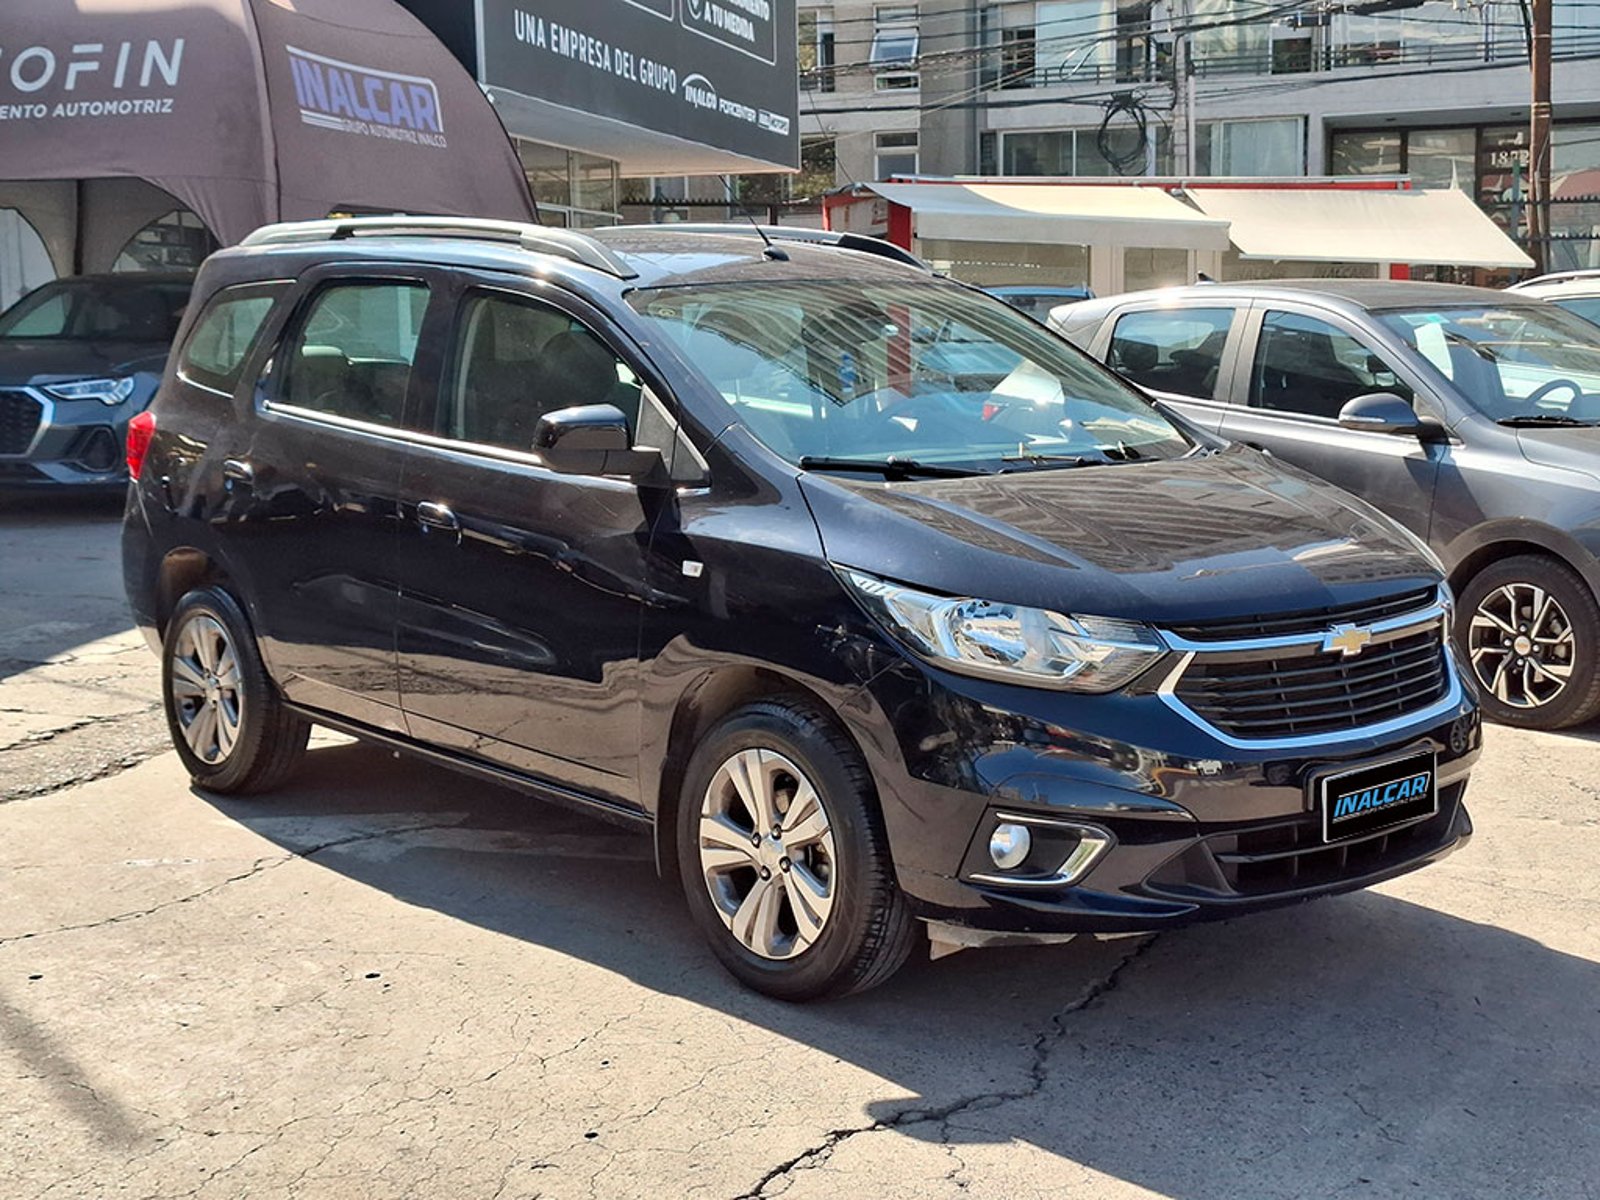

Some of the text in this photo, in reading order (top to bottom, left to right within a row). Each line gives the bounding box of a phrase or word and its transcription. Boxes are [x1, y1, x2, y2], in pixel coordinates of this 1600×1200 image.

[704, 1, 711, 23] A
[711, 3, 723, 28] TU
[0, 38, 184, 93] OFIN
[514, 9, 546, 49] UNA
[550, 22, 611, 72] EMPRESA
[614, 48, 637, 82] DEL
[639, 58, 677, 95] GRUPO
[52, 98, 174, 118] AUTOMOTRIZ
[289, 55, 439, 133] INALCAR
[1333, 776, 1426, 818] INALCAR
